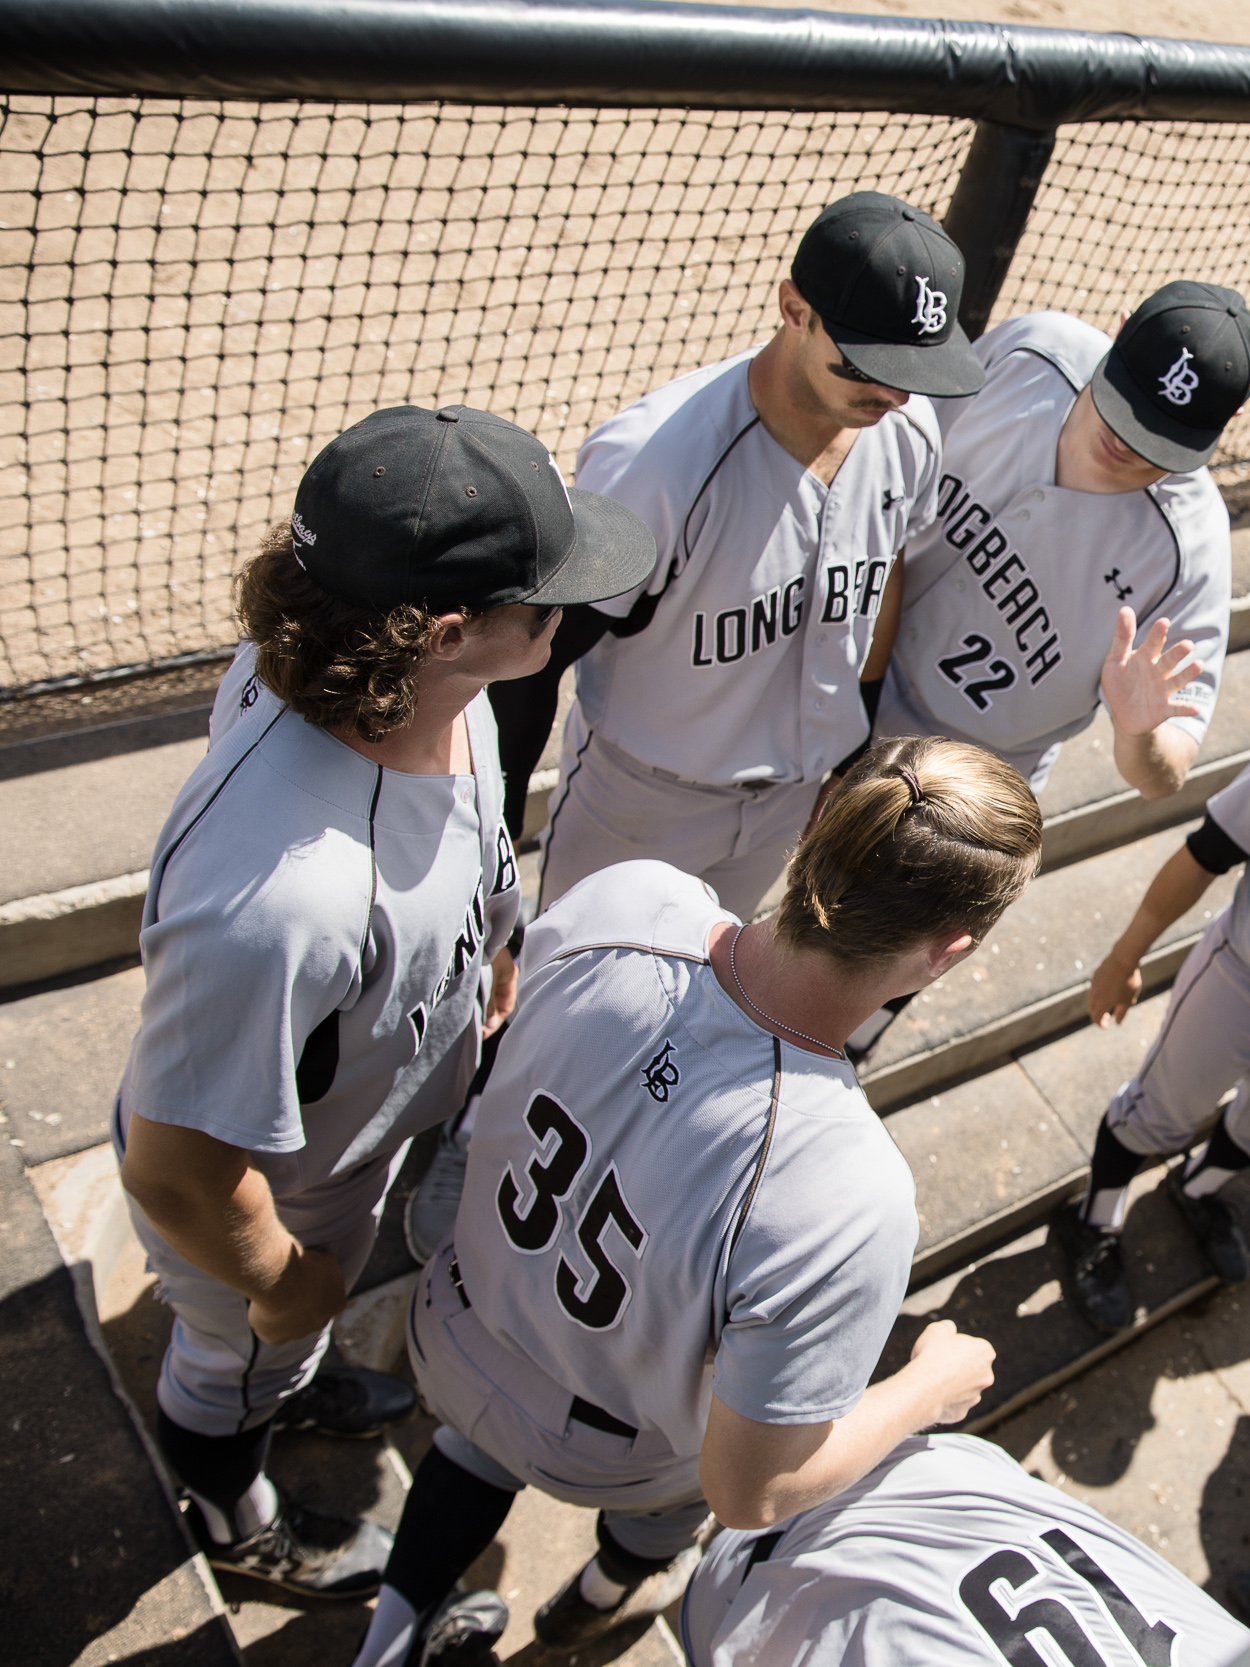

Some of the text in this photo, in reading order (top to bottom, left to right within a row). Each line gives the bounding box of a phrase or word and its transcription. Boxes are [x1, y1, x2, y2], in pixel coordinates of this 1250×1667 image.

[690, 575, 806, 668] LONG
[939, 633, 1017, 715] 22
[497, 1089, 648, 1331] 35
